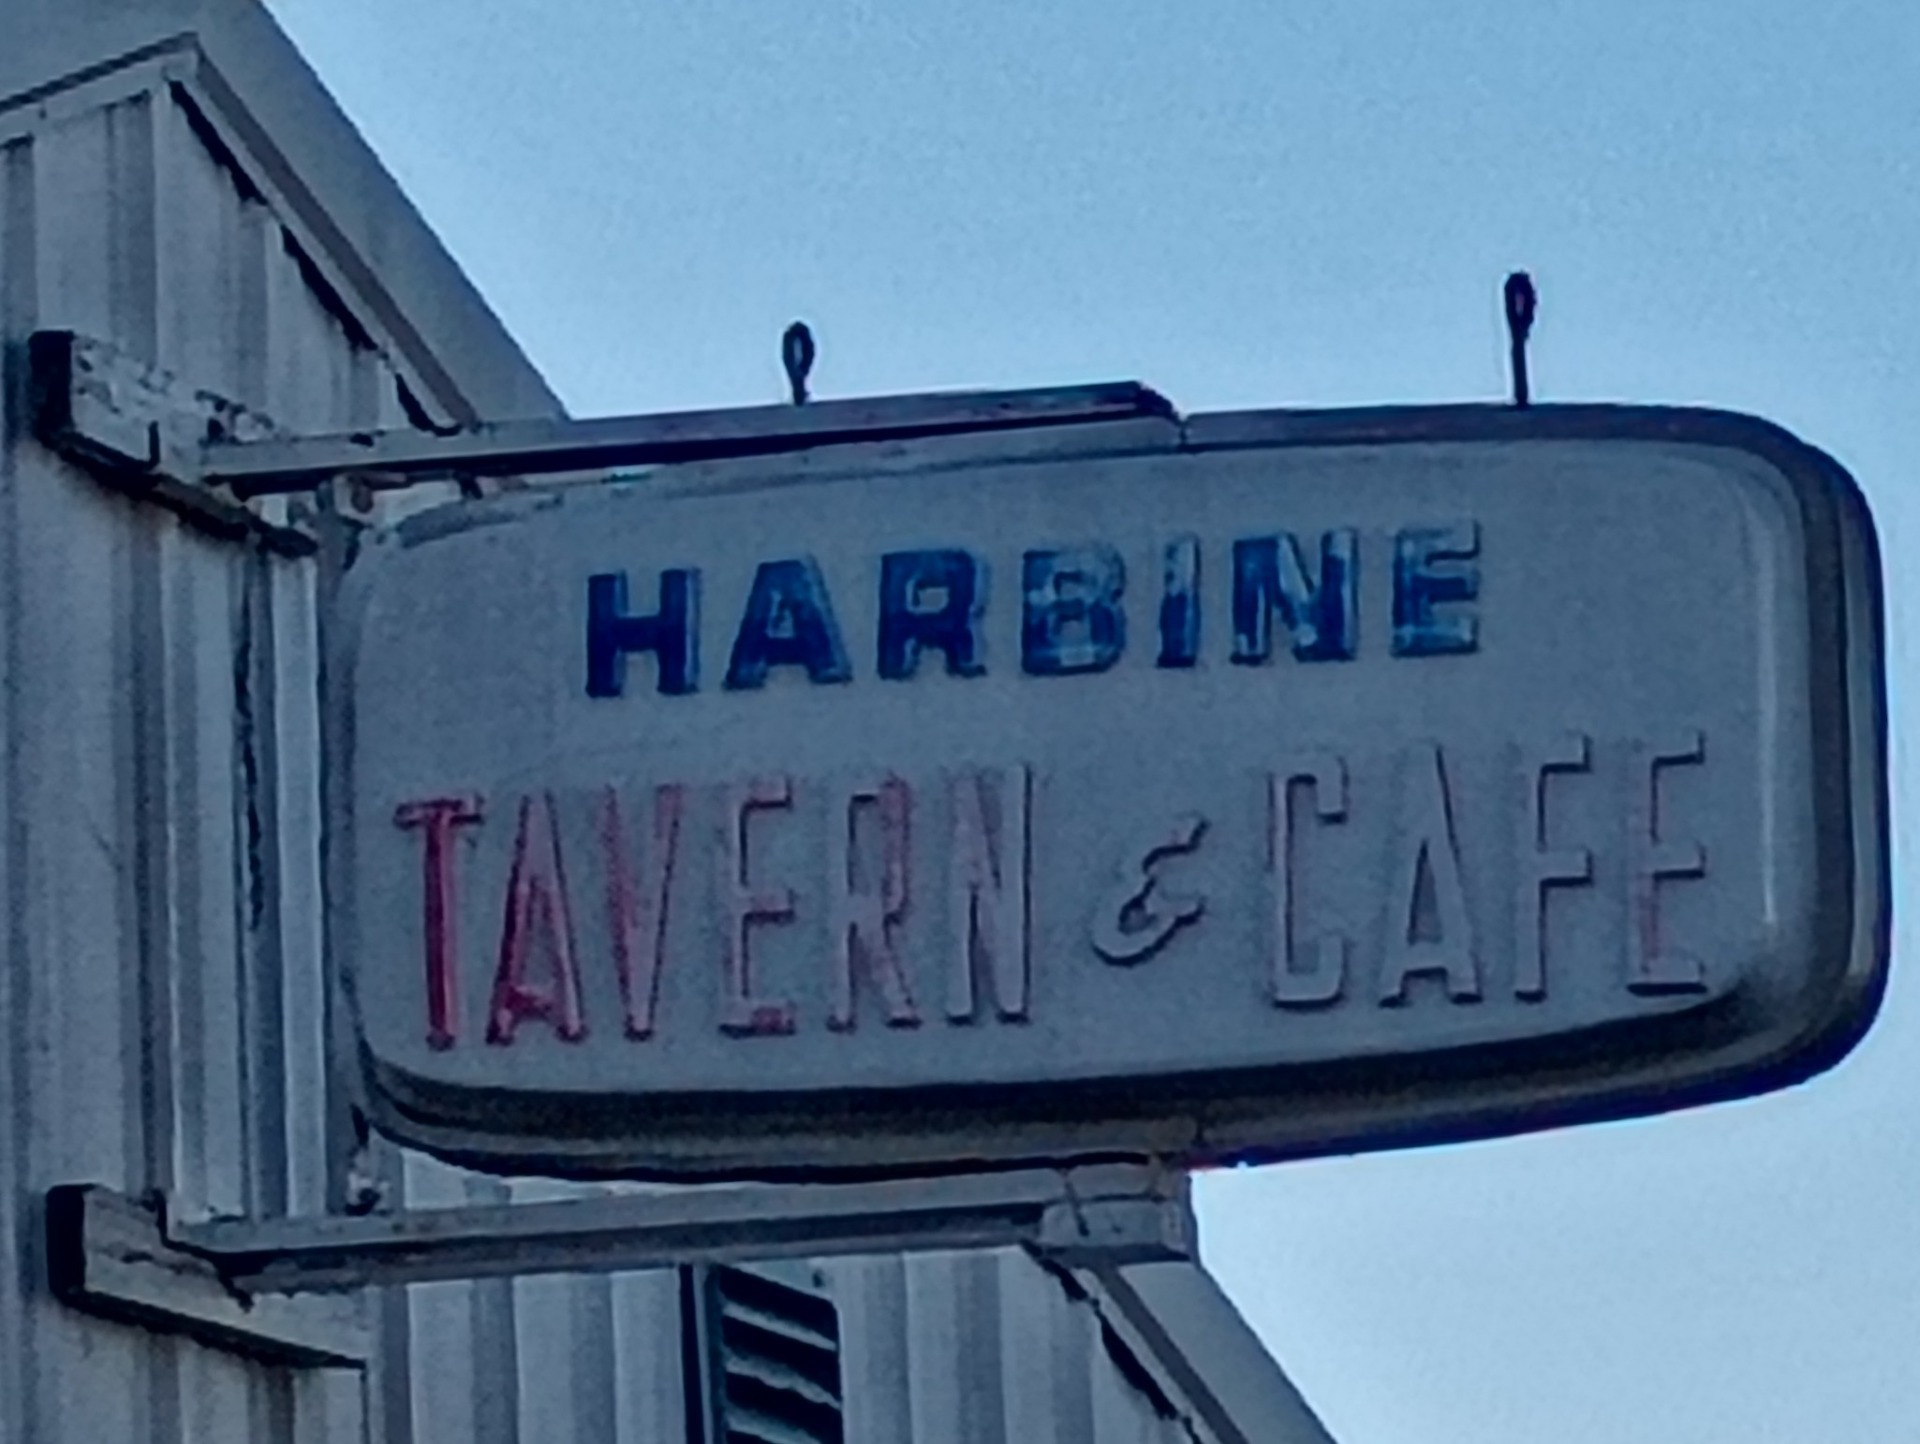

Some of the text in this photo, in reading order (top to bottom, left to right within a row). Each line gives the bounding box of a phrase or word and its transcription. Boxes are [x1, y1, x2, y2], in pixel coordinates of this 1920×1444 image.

[586, 520, 1482, 699] HARBINE
[395, 728, 1708, 1051] TAVERN & CAFE
